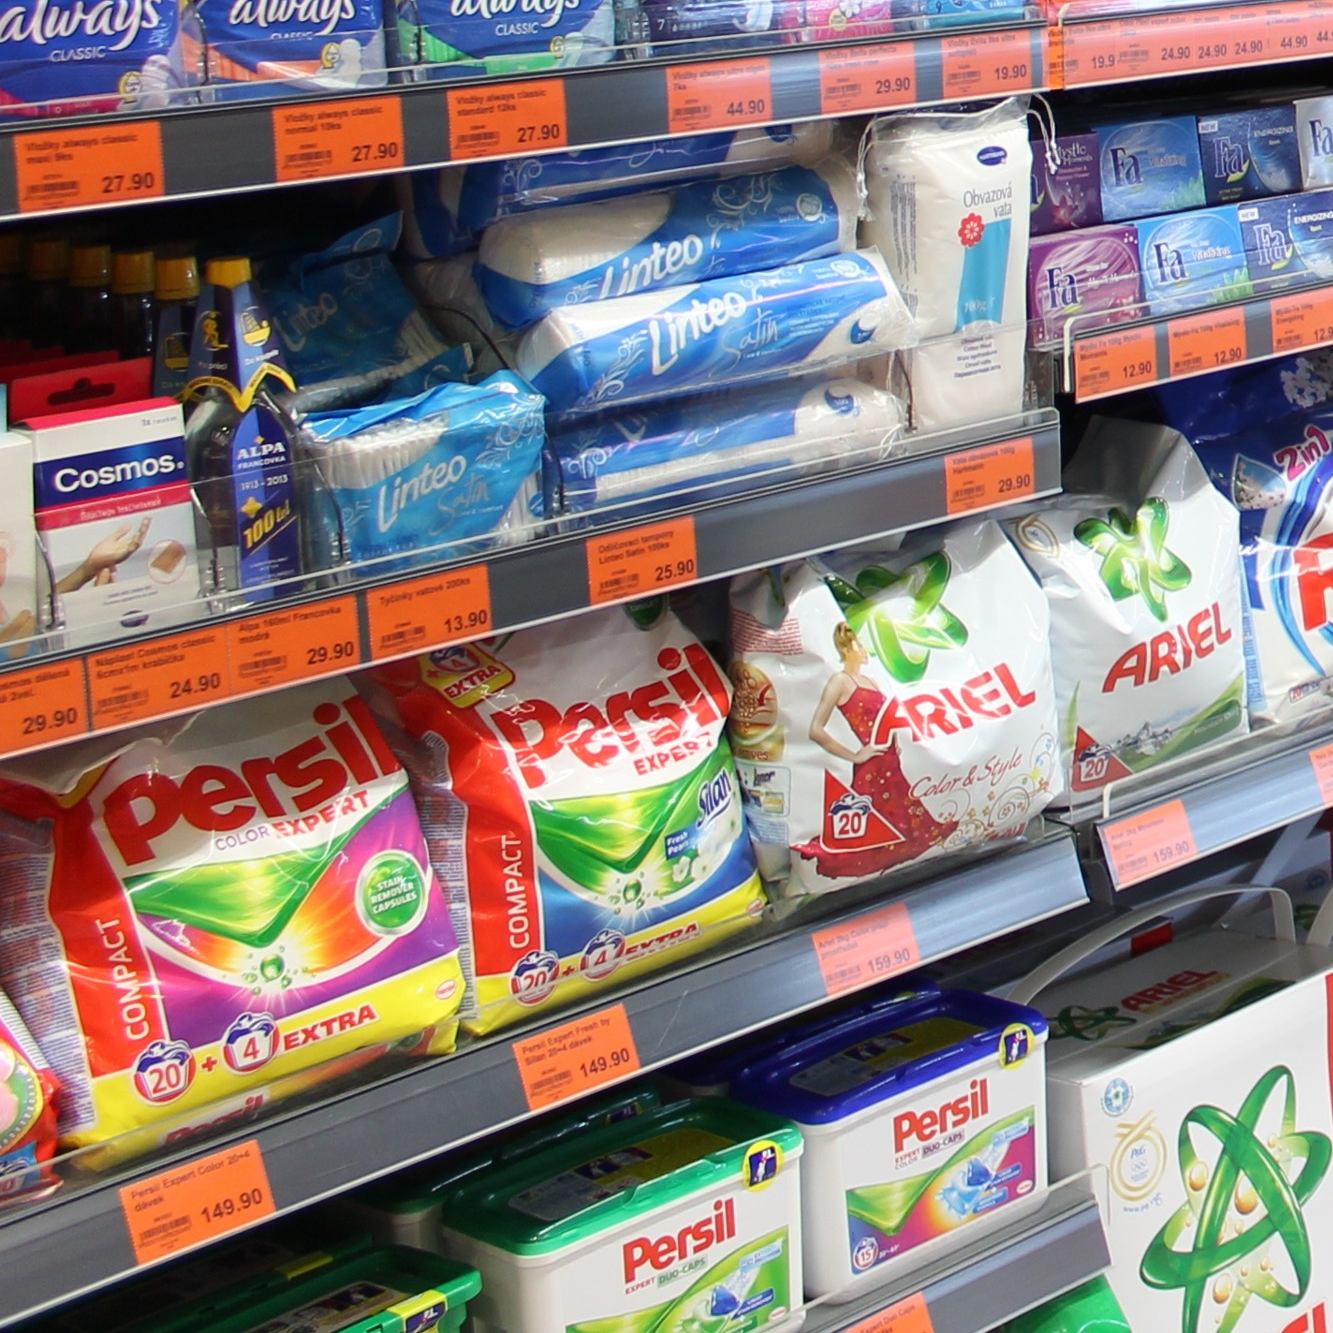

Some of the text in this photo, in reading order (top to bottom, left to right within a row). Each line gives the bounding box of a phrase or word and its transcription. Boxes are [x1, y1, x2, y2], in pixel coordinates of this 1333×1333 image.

[495, 22, 539, 36] CLASSIC
[1161, 45, 1191, 61] 24.90
[1198, 43, 1227, 59] 24.90
[1280, 34, 1308, 50] 44.90
[994, 64, 1027, 81] 19.90
[726, 99, 765, 117] 44.90
[517, 123, 560, 144] 27.90
[351, 141, 399, 164] 27.90
[1109, 147, 1144, 188] Fa
[102, 171, 155, 195] 27.90
[962, 182, 1013, 208] Obvazová
[993, 201, 1012, 217] vata
[649, 292, 748, 375] Linteo
[1214, 347, 1242, 364] 12.90
[1123, 361, 1151, 378] 12.90
[236, 441, 286, 461] ALPA
[1276, 424, 1333, 480] 2in1
[55, 452, 175, 493] Cosmos
[998, 474, 1031, 493] 29.90
[377, 454, 465, 532] Linteo
[655, 558, 695, 582] 25.90
[444, 609, 488, 635] 13.90
[306, 641, 354, 666] 29.90
[1102, 601, 1233, 694] ARIEL
[170, 673, 222, 699] 24.90
[492, 646, 729, 788] Persil
[873, 662, 1037, 749] ARIEL
[22, 707, 78, 736] 29.90
[906, 748, 1024, 801] Color & Style
[1084, 758, 1105, 778] 20
[102, 696, 405, 868] Persil
[214, 790, 370, 851] COLOR EXPERT
[839, 810, 861, 835] 20
[1153, 840, 1190, 862] 159.90
[371, 882, 414, 906] REMOVER
[372, 892, 418, 914] CAPSULES
[509, 834, 530, 949] COMPACT
[867, 948, 911, 973] 159.90
[96, 917, 149, 1041] COMPACT
[579, 1048, 630, 1078] 149.90
[893, 1077, 989, 1153] Persil
[133, 1194, 165, 1213] dávek
[200, 1187, 263, 1225] 149.90
[622, 1197, 736, 1284] Persil
[860, 1249, 871, 1262] 15
[625, 1277, 656, 1294] EXPERT
